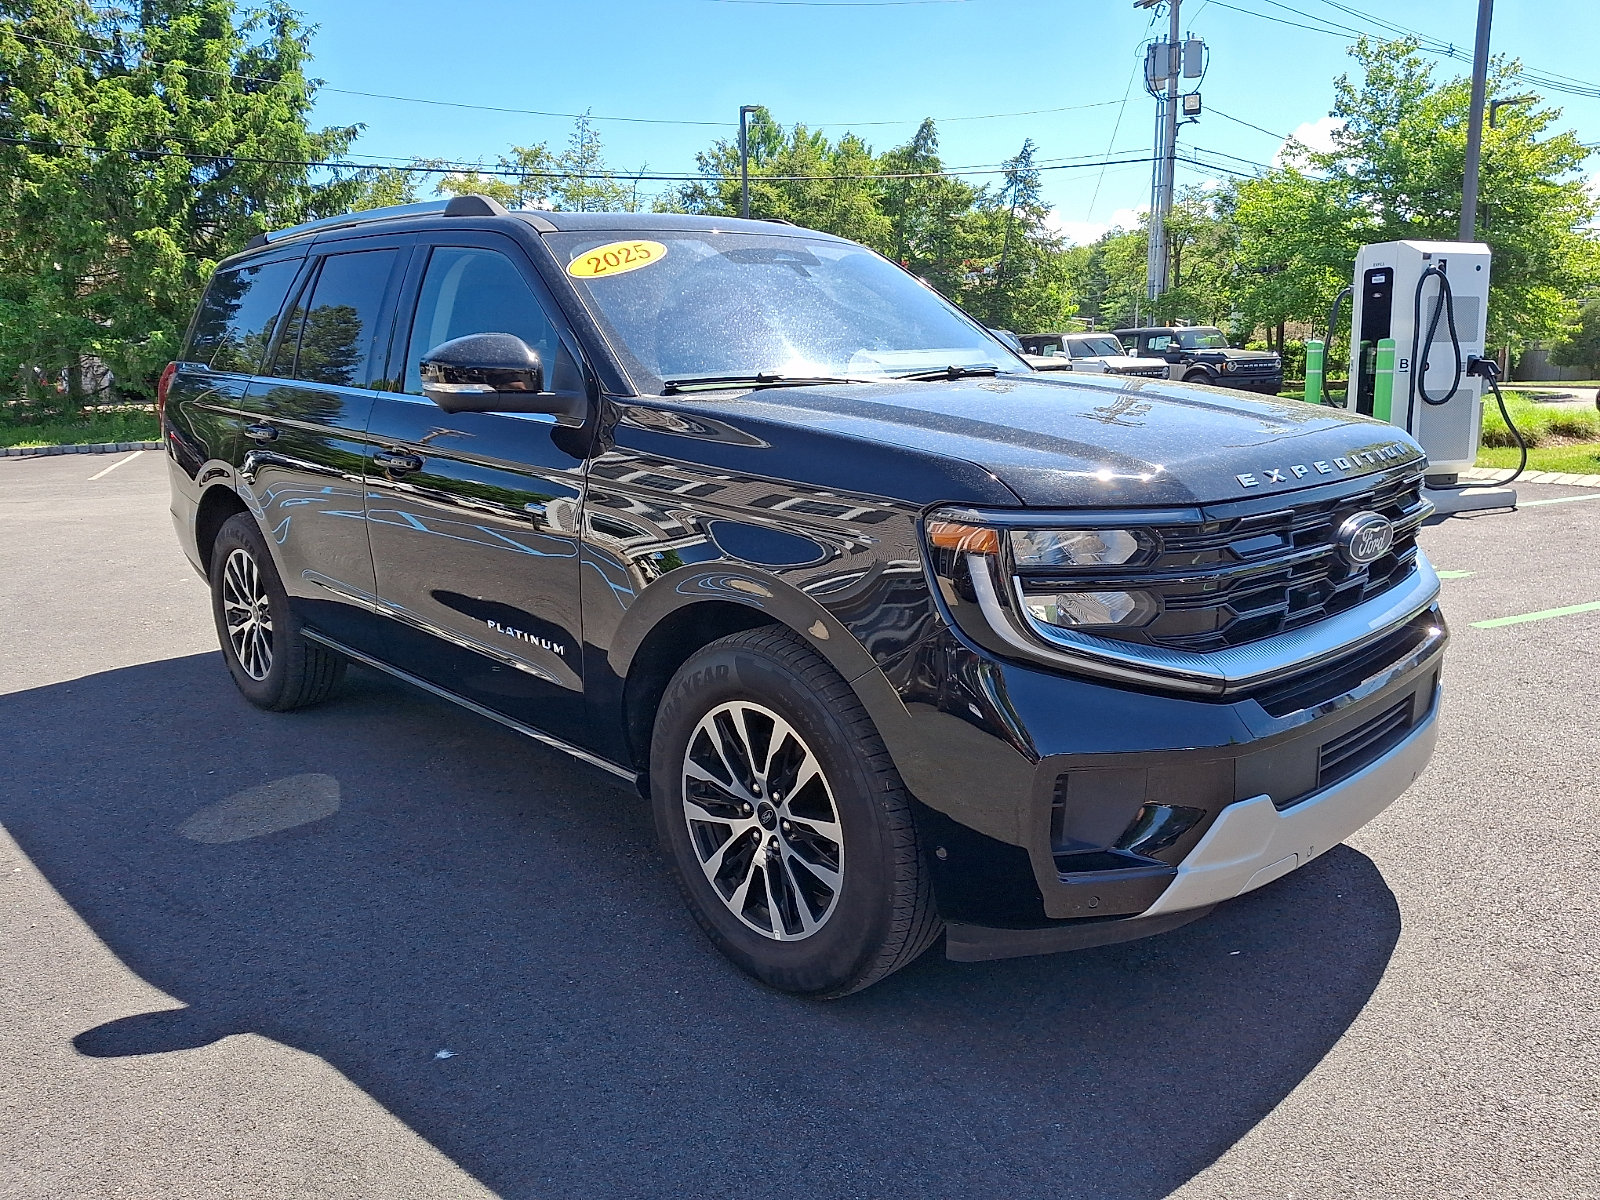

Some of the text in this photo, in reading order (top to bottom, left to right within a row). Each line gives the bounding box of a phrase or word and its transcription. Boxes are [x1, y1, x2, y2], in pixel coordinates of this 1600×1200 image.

[587, 244, 651, 273] 2025
[1400, 359, 1409, 369] B
[1358, 527, 1387, 557] Ford
[487, 620, 565, 655] PLATINUM
